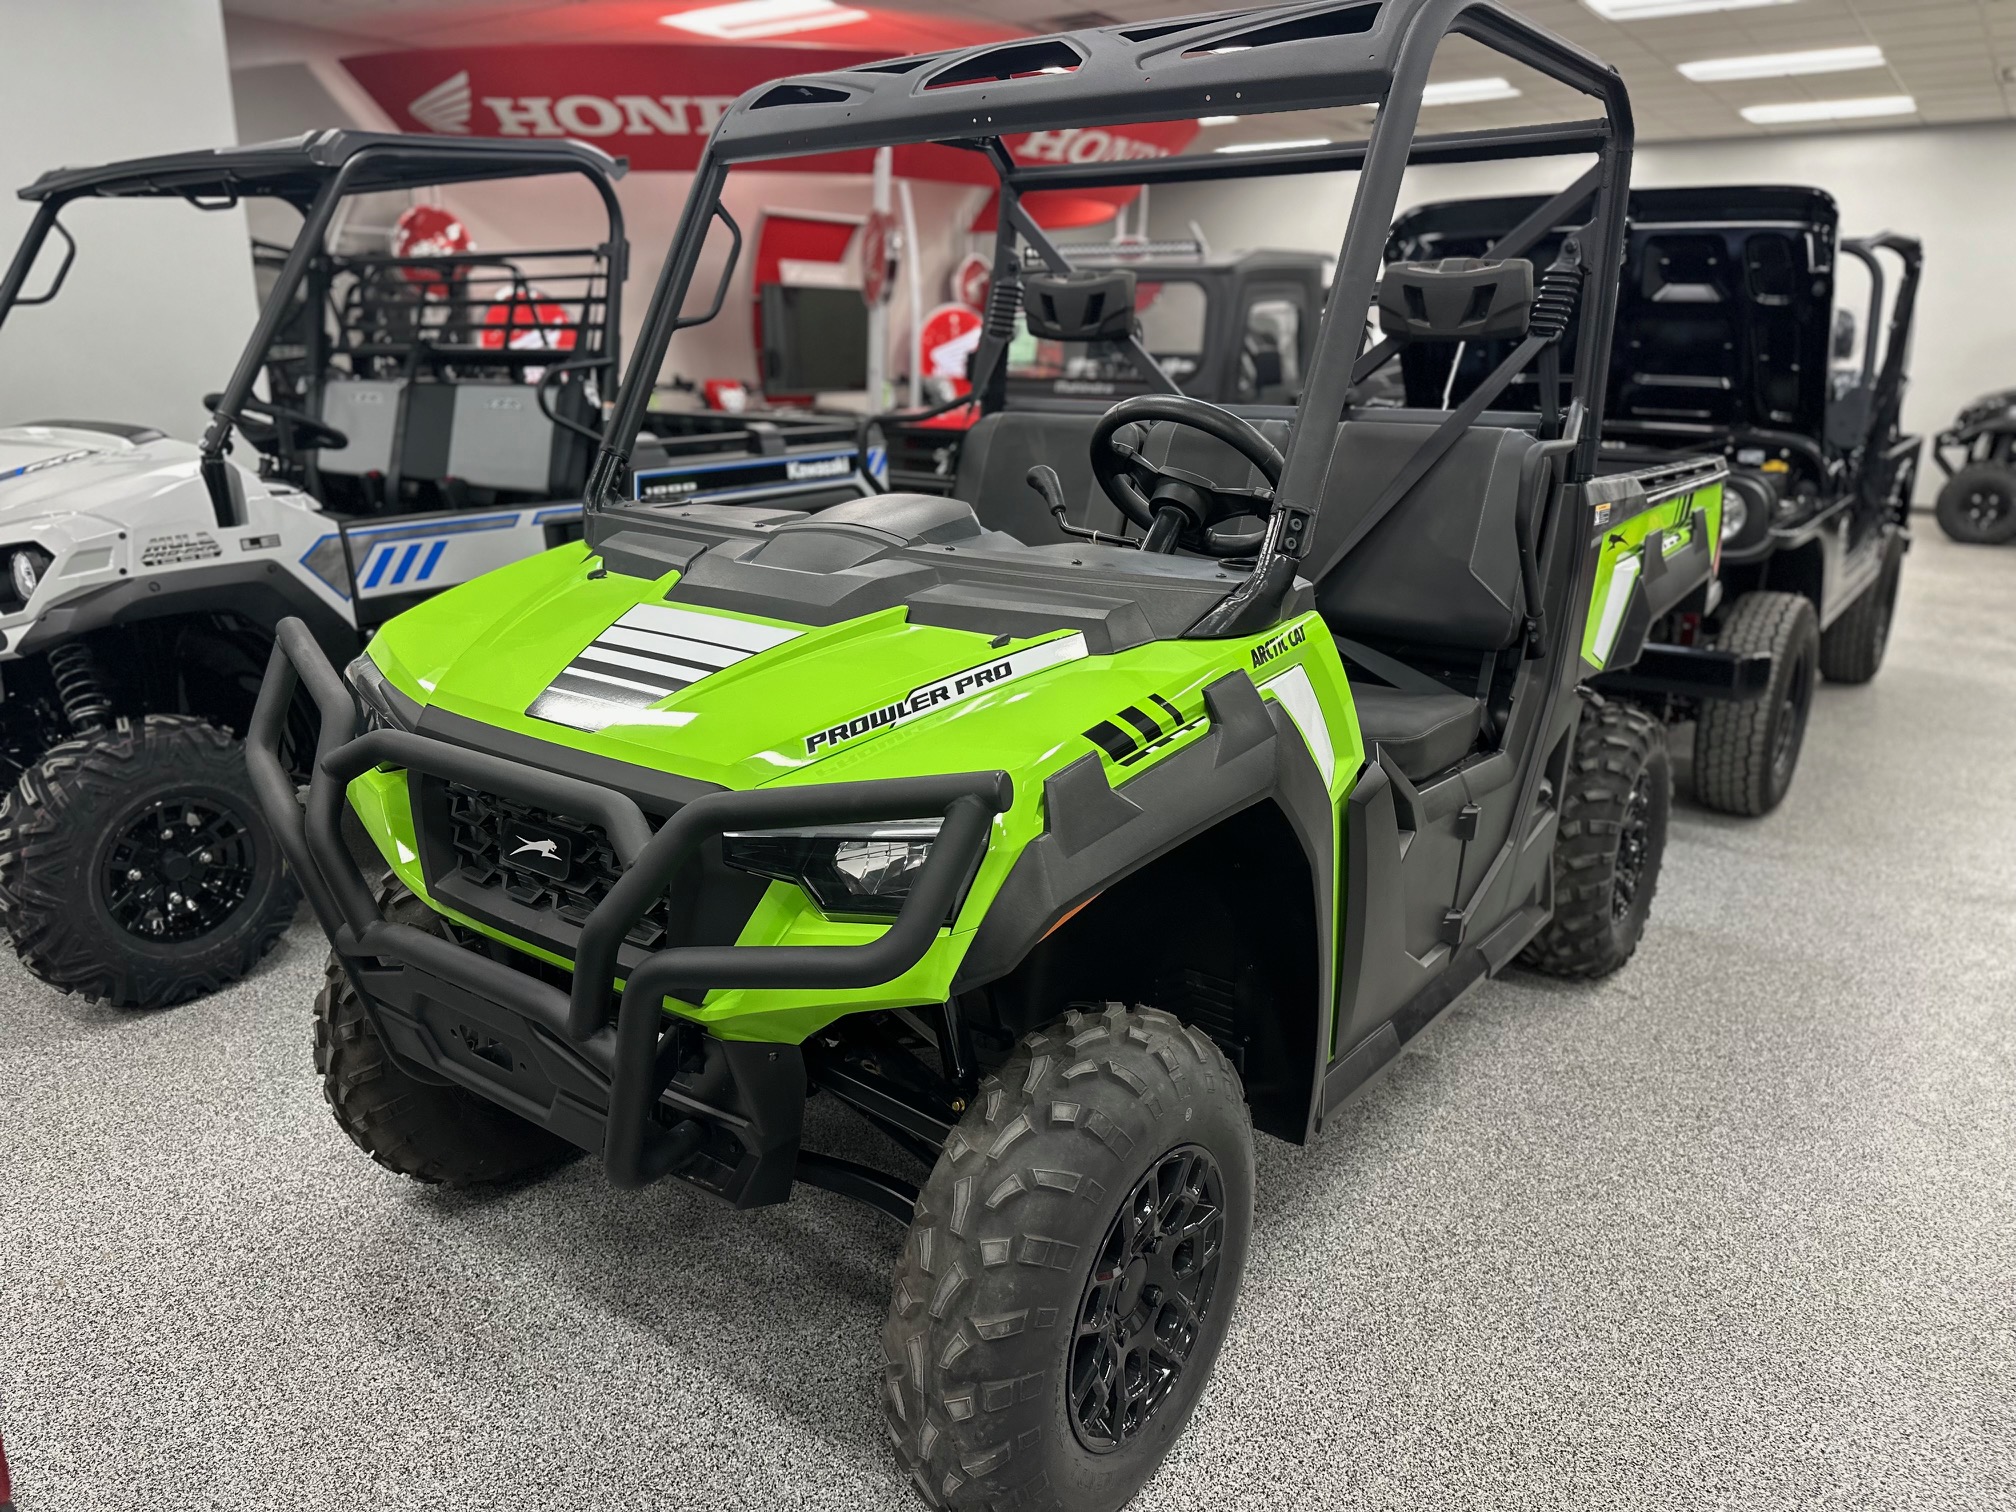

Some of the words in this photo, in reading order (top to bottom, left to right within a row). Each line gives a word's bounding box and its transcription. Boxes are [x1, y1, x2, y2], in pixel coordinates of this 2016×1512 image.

[786, 456, 849, 480] Kawasaki
[1250, 632, 1288, 669] ARCTIC
[1287, 624, 1306, 647] CAT
[805, 685, 950, 755] PROWLER
[954, 661, 1013, 696] PRO
